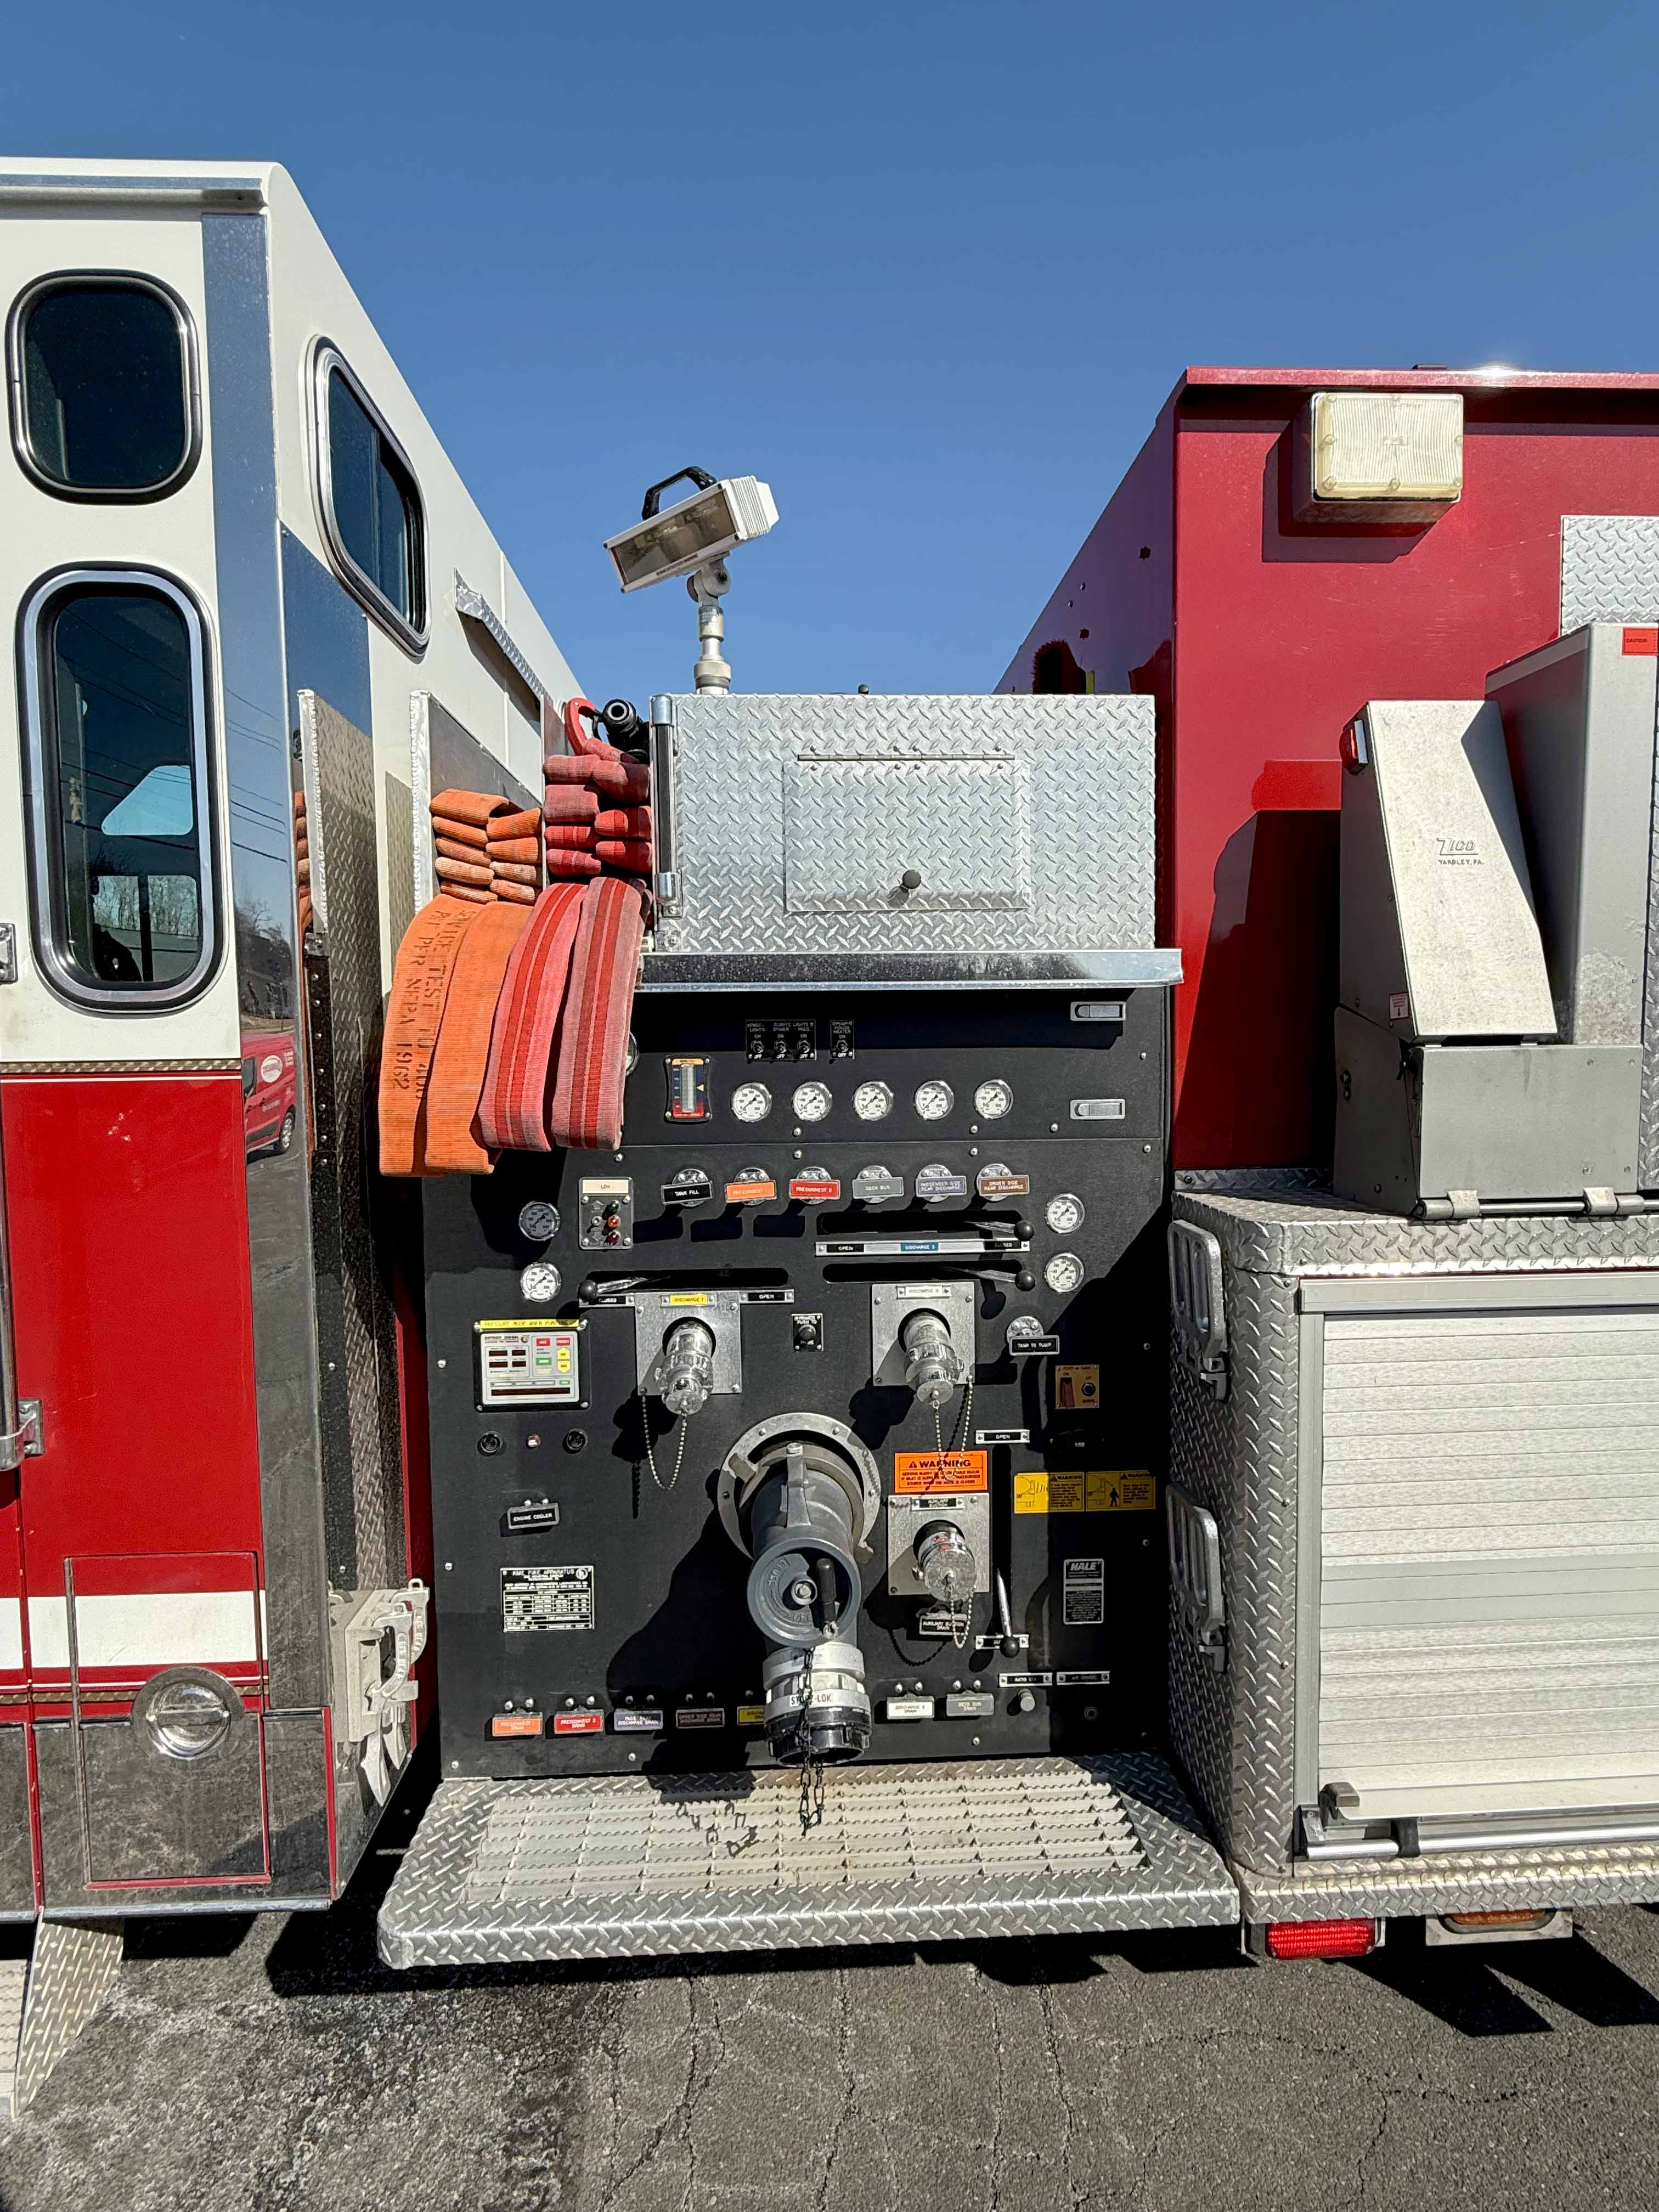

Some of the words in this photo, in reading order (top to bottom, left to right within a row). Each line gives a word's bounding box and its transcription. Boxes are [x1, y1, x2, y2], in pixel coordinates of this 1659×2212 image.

[411, 937, 434, 966] PER
[422, 965, 447, 1011] TEST
[1070, 1562, 1097, 1571] HALE
